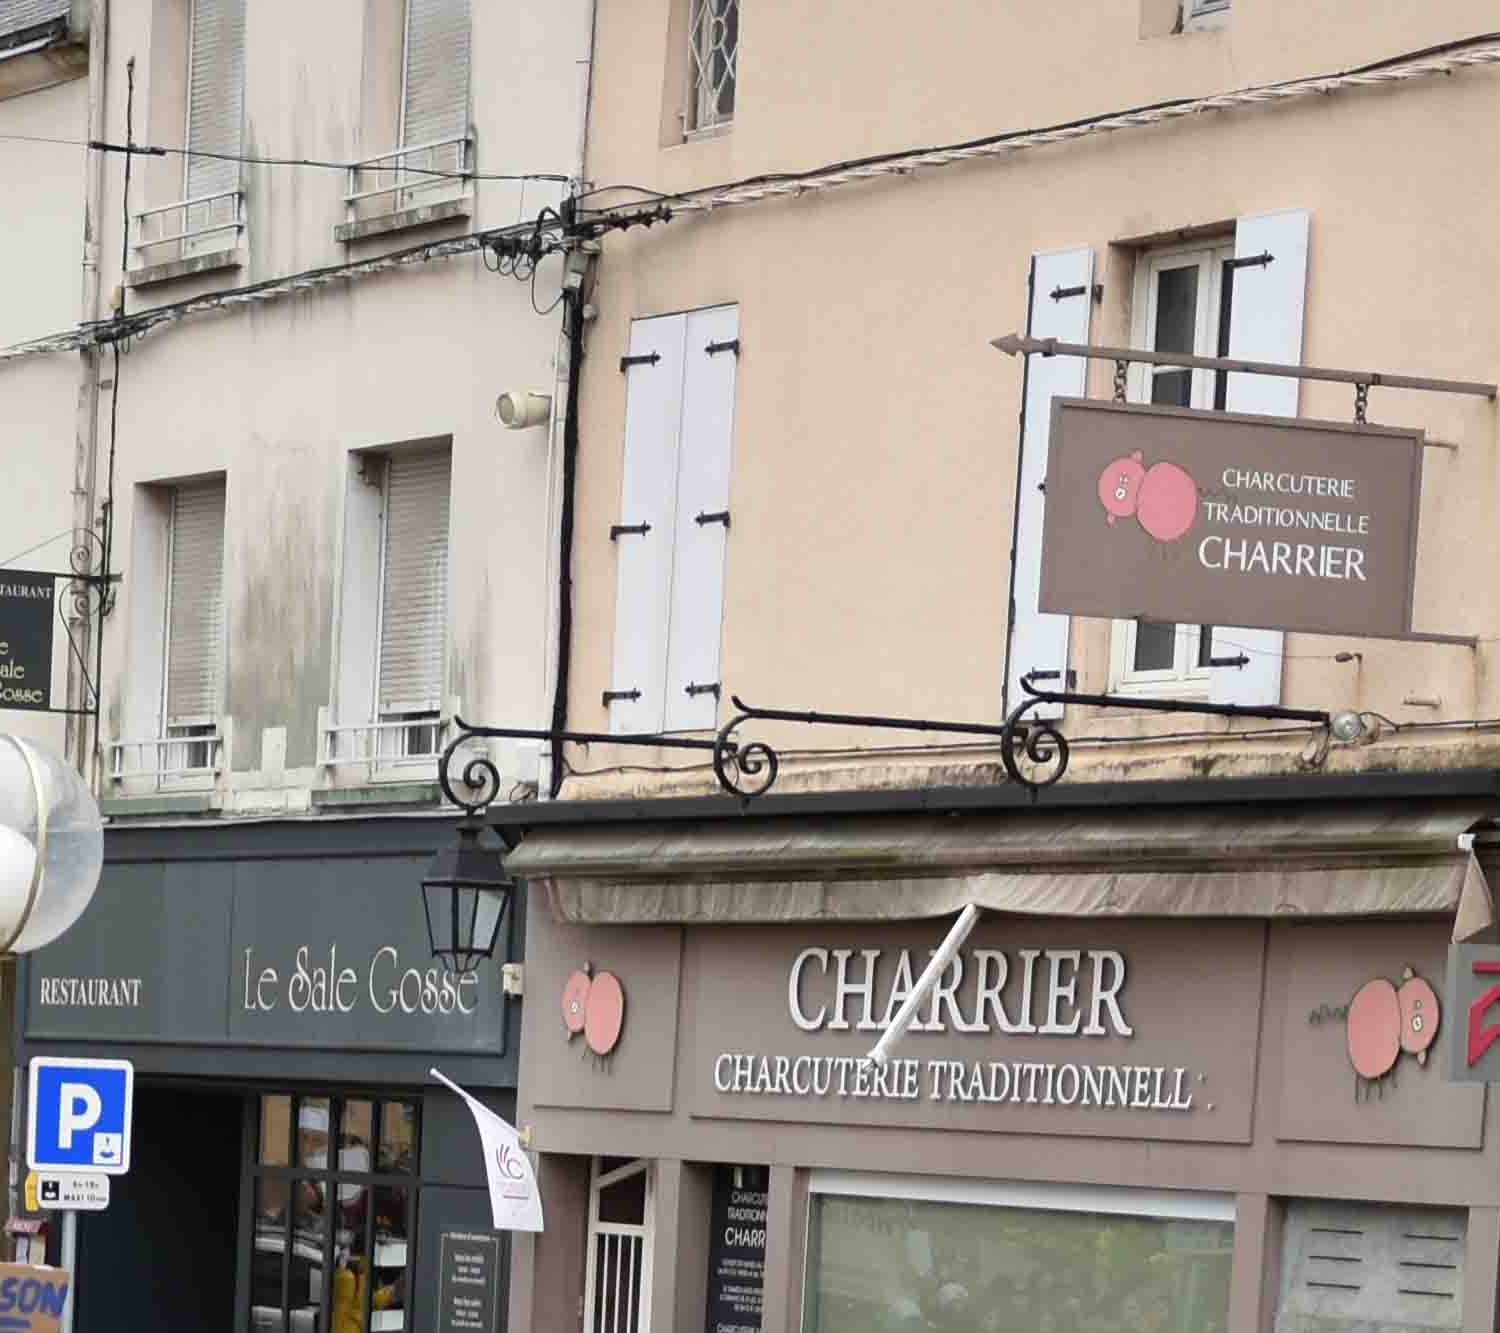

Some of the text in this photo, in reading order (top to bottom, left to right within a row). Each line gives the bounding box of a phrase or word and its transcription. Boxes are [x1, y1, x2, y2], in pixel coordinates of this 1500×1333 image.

[1222, 468, 1355, 498] CHARCUTERIE
[1203, 502, 1369, 535] TRADITIONNELLE
[1199, 537, 1368, 581] CHARRIER
[40, 976, 143, 1007] RESTAURANT
[242, 941, 480, 1014] Le Sale Gosse
[788, 947, 1134, 1037] CHARRIER
[713, 1052, 920, 1100] CHARCUTERIE
[58, 1081, 102, 1150] P
[725, 1227, 766, 1248] CHARR
